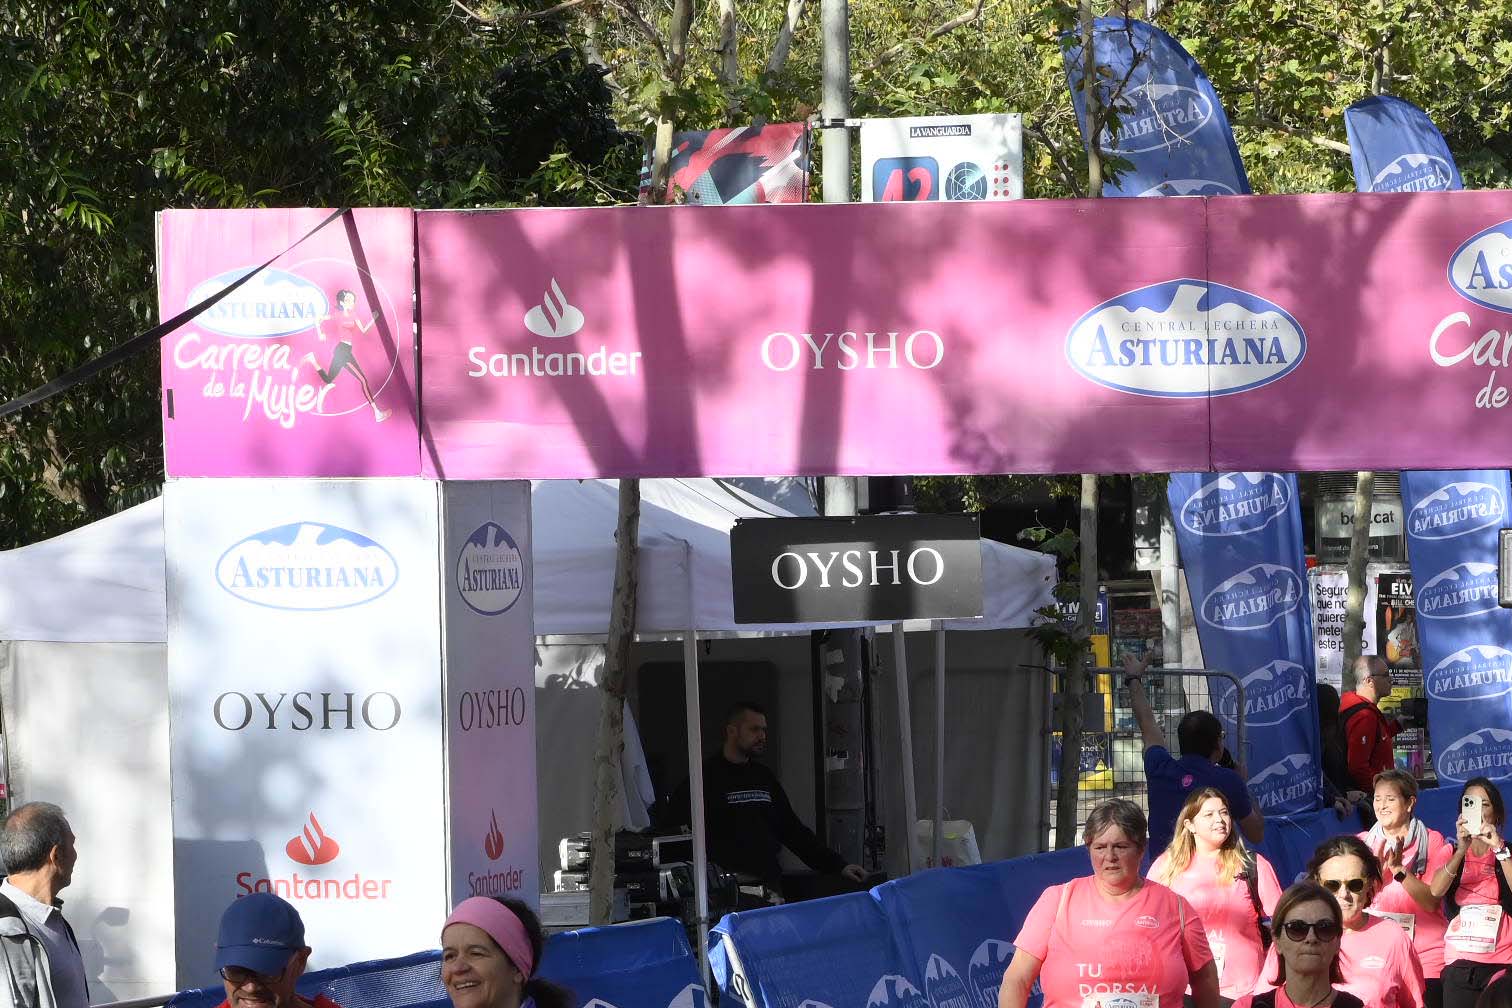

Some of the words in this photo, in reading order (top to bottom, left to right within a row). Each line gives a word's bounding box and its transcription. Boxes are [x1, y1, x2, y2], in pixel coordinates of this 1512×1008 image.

[1121, 320, 1196, 332] CENTRAL
[1203, 319, 1280, 331] LECHERA
[174, 333, 292, 369] Carrera
[468, 346, 642, 377] Santander
[761, 331, 945, 372] OYSHO
[1086, 324, 1287, 367] ASTURIANA
[203, 376, 224, 397] de
[229, 376, 246, 397] la
[243, 365, 335, 428] Mujer
[1475, 370, 1510, 409] de
[230, 556, 386, 588] ASTURIANA
[462, 558, 521, 593] ASTURIANA
[771, 546, 945, 591] OYSHO
[1317, 602, 1332, 611] que
[1319, 641, 1337, 650] este
[213, 690, 402, 731] OYSHO
[459, 686, 526, 732] OYSHO
[236, 871, 392, 900] Santander
[468, 864, 526, 899] Santander
[1076, 962, 1102, 978] TU
